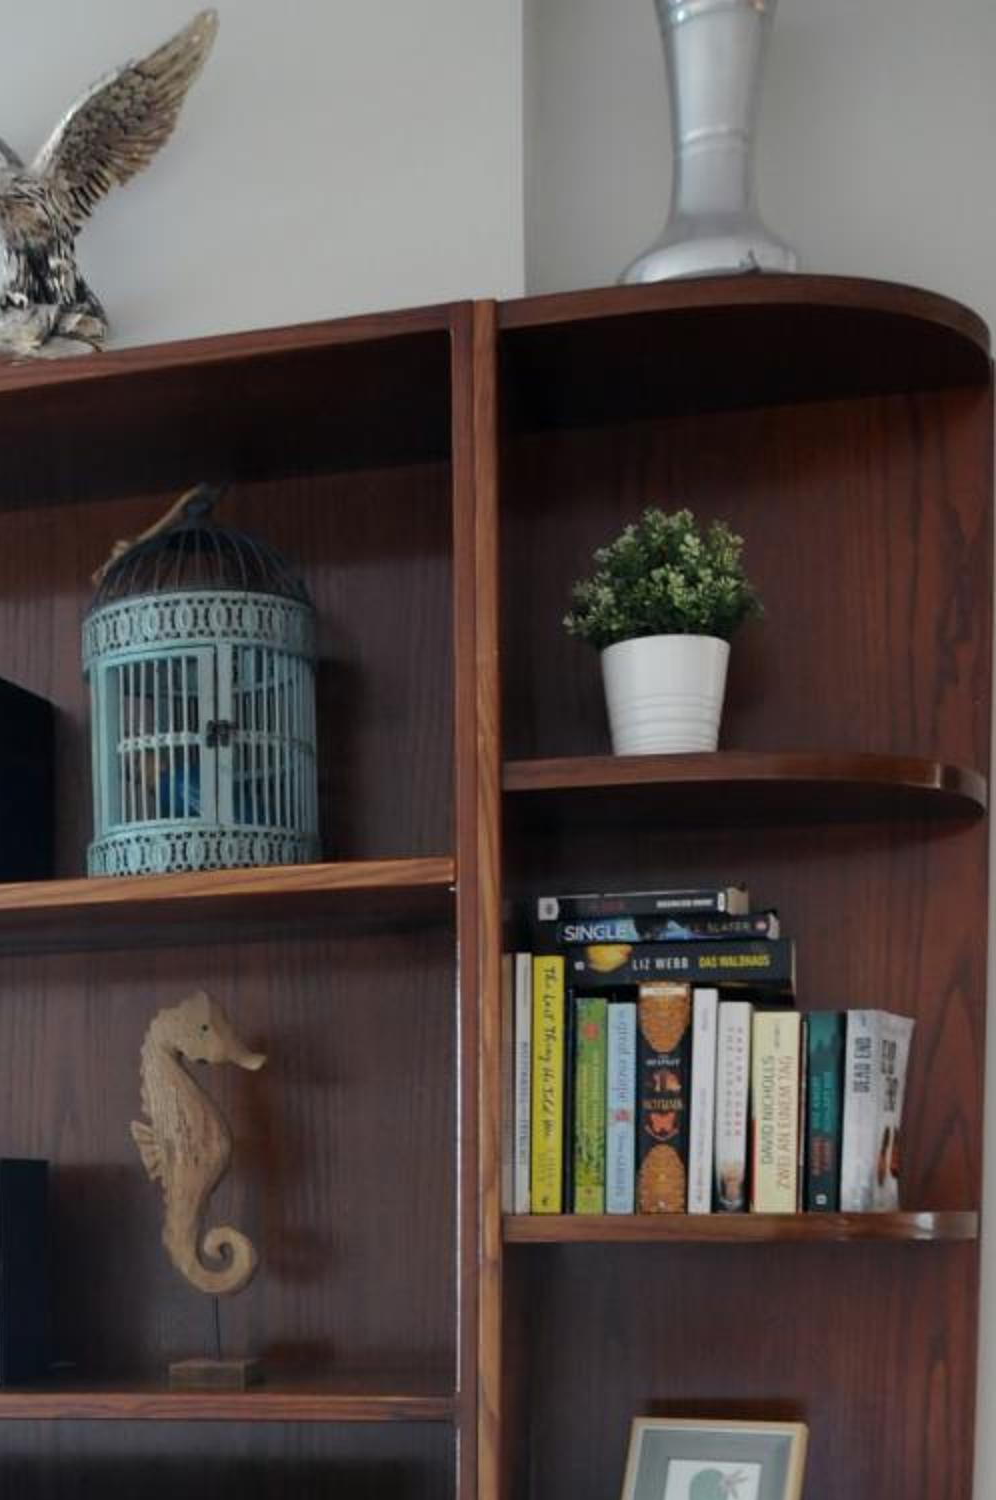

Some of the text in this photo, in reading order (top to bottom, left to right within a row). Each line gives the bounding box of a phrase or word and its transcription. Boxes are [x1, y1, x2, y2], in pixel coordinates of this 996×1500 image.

[564, 925, 627, 941] SINGLE
[632, 958, 650, 971] LIZ
[655, 956, 689, 970] WEBB
[853, 1062, 871, 1093] DEAD
[761, 1055, 775, 1165] DAVID NICHOLLS
